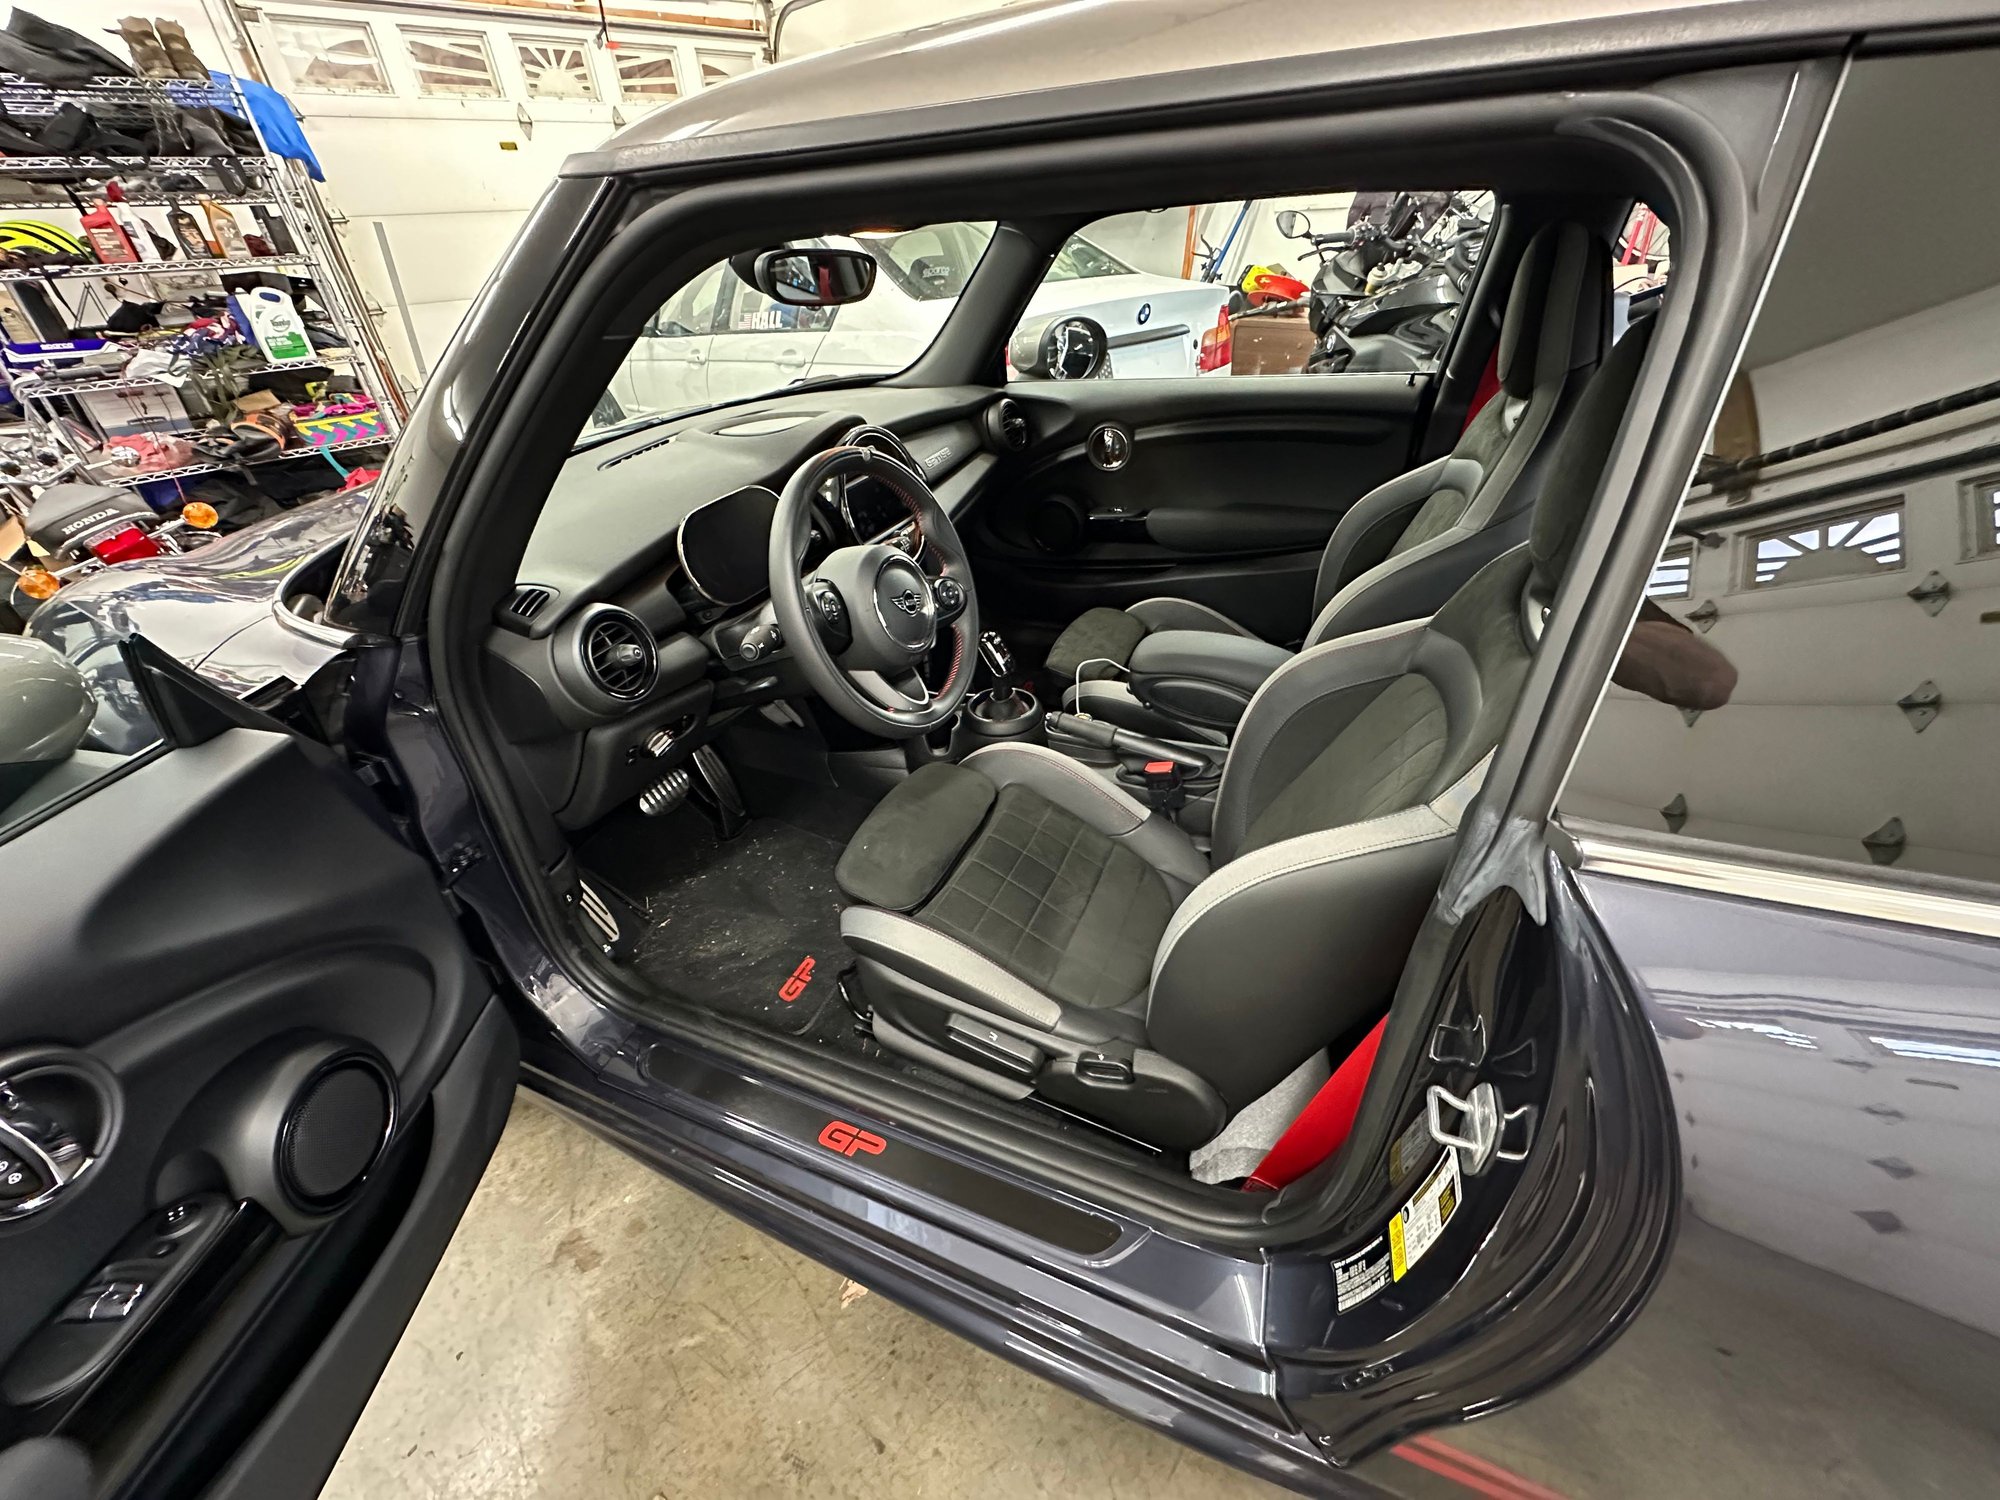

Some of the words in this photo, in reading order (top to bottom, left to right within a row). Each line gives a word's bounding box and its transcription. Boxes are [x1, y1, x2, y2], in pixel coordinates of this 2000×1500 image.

[751, 310, 783, 330] HALL
[61, 507, 120, 535] HONDA
[778, 956, 817, 1003] GP
[818, 1120, 887, 1157] GP
